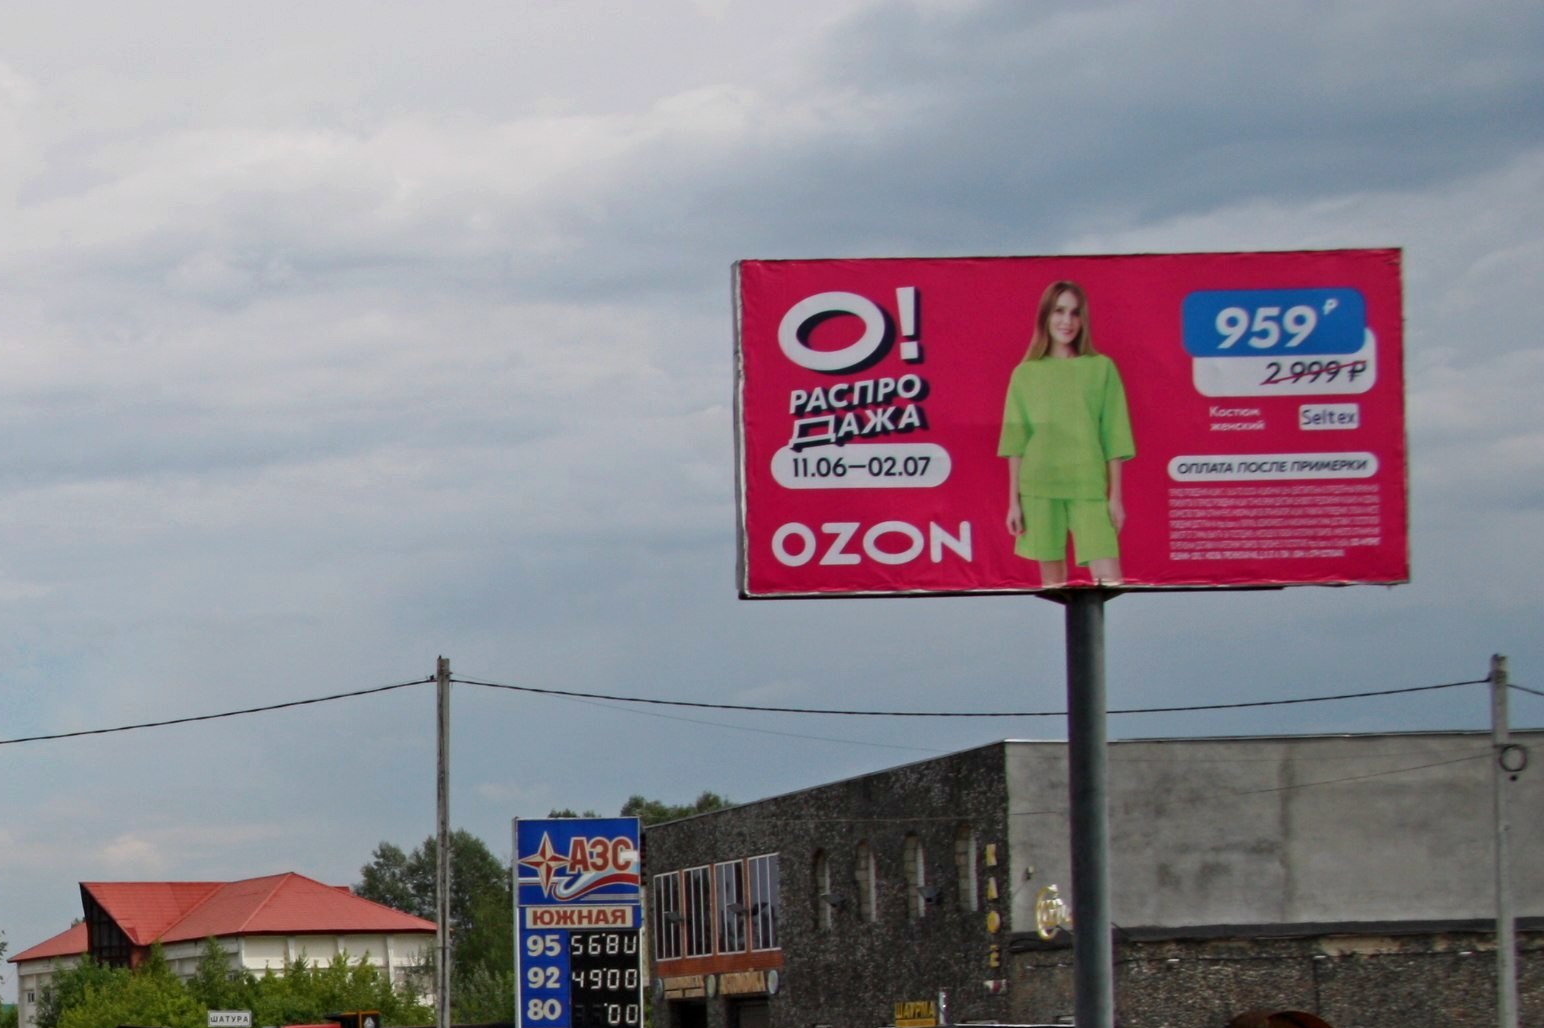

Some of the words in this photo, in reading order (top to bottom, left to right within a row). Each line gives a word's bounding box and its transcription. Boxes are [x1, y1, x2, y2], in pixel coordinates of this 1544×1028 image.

[1215, 305, 1317, 349] 959
[789, 374, 921, 414] РАСПРО
[788, 404, 920, 448] ДАЖА
[1301, 408, 1356, 426] Seltex
[1177, 462, 1233, 474] ОПЛАТА
[1237, 461, 1286, 473] ПОСЛЕ
[1290, 459, 1368, 471] ПРИМЕРКИ
[771, 520, 973, 567] OZON
[566, 836, 634, 874] АЗС
[532, 909, 627, 926] ЮЖНАЯ
[526, 935, 561, 957] 95
[527, 966, 561, 989] 92
[210, 1015, 249, 1023] ШАТУРА
[527, 999, 562, 1021] 80
